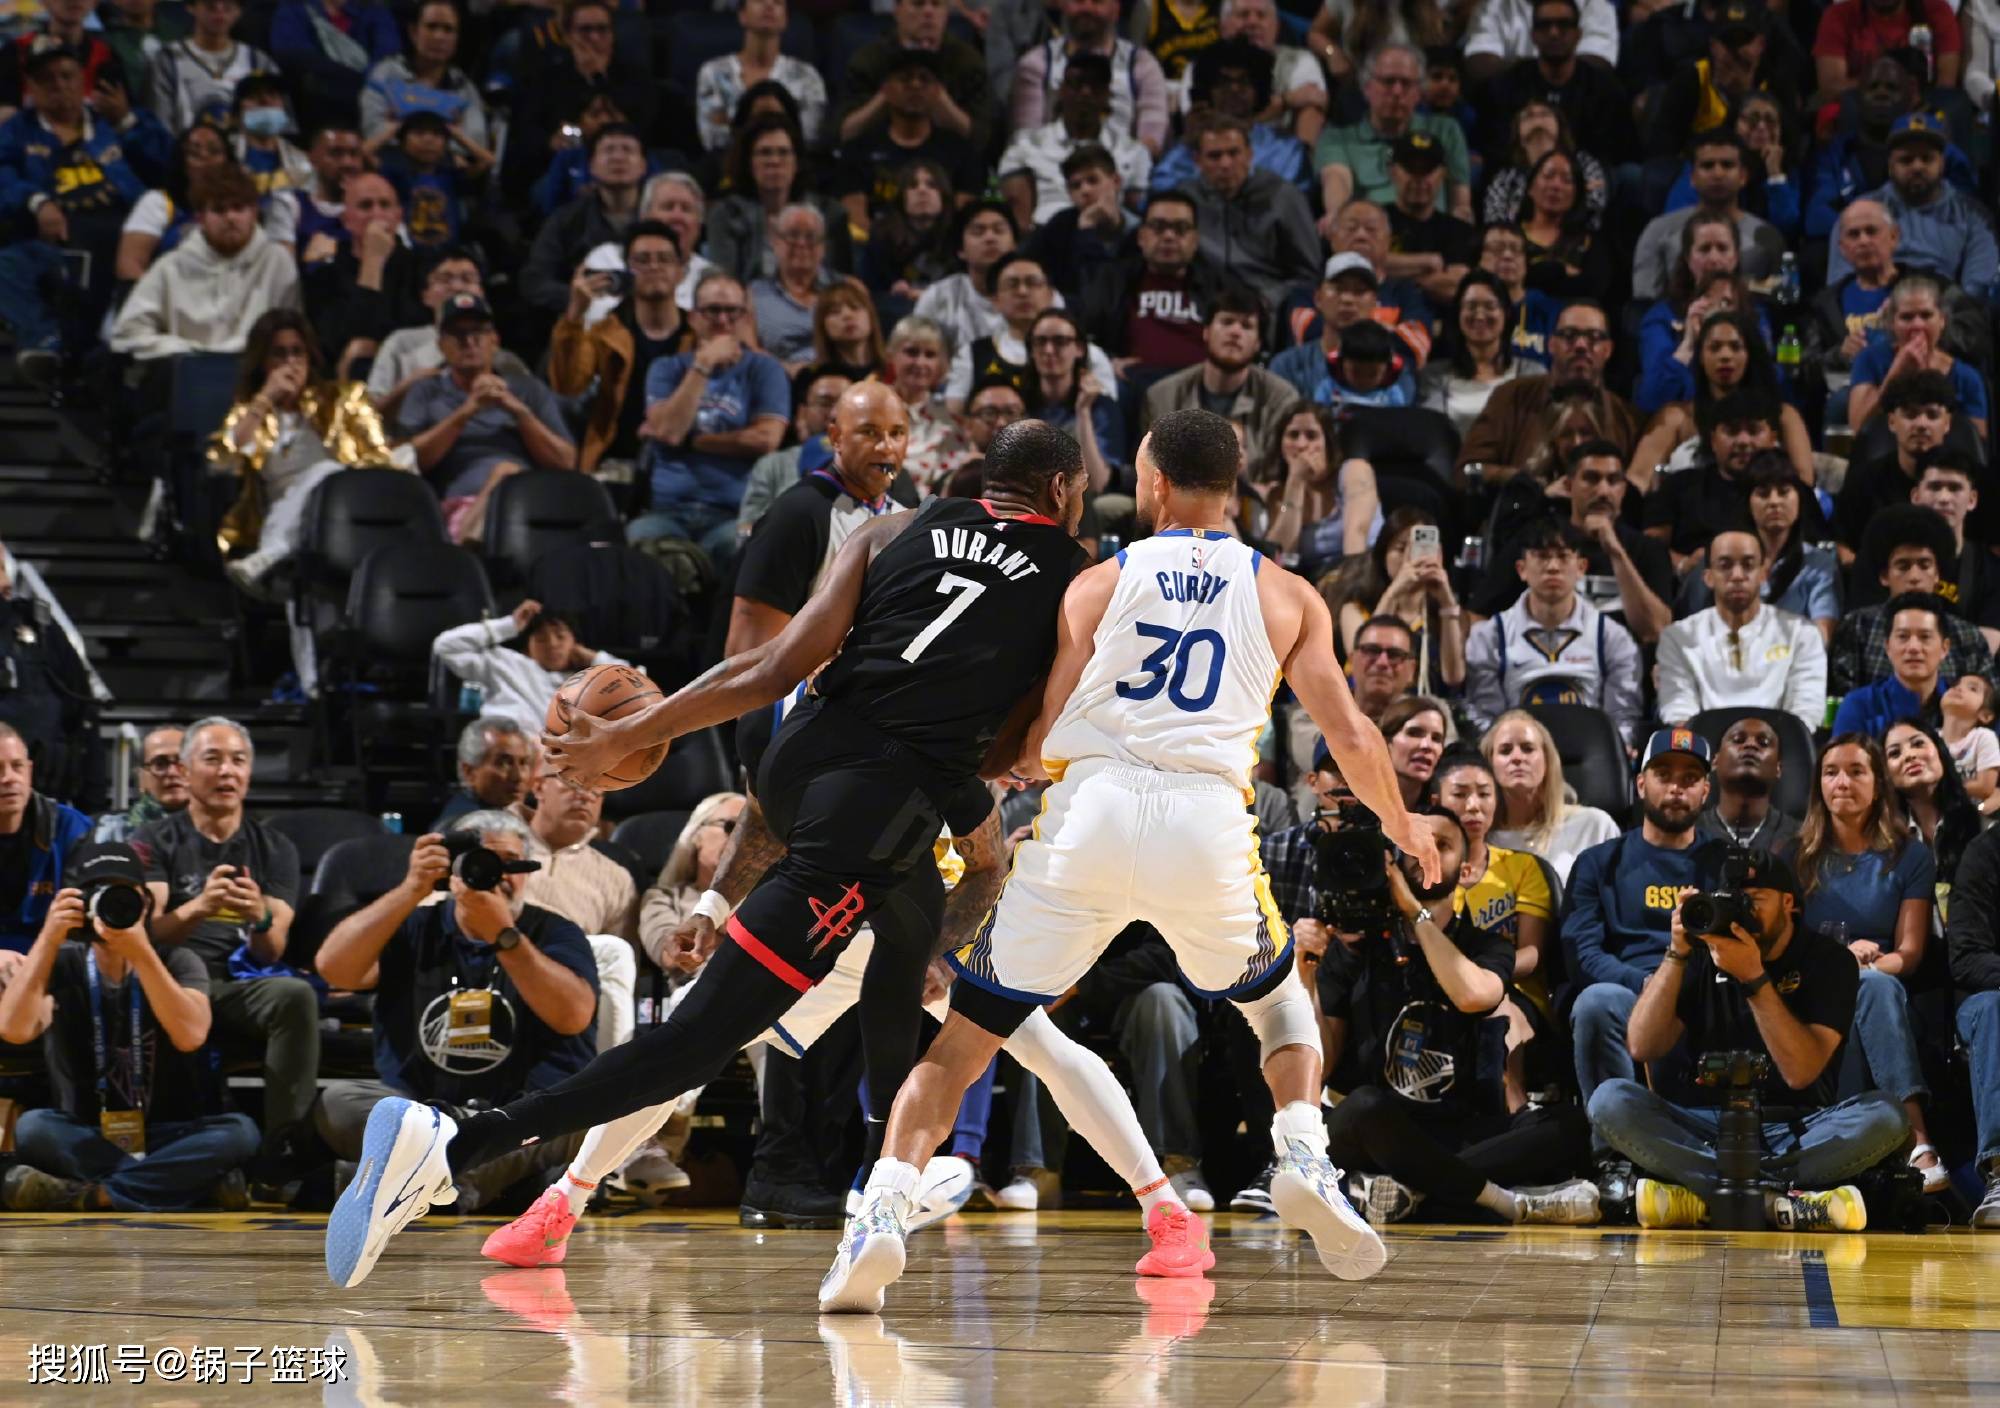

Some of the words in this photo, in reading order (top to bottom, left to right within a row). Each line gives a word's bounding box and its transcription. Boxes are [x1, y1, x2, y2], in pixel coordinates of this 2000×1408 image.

[930, 528, 1040, 581] DURANT
[1156, 571, 1229, 605] CURRY
[901, 571, 987, 664] 7
[1116, 621, 1227, 713] 30
